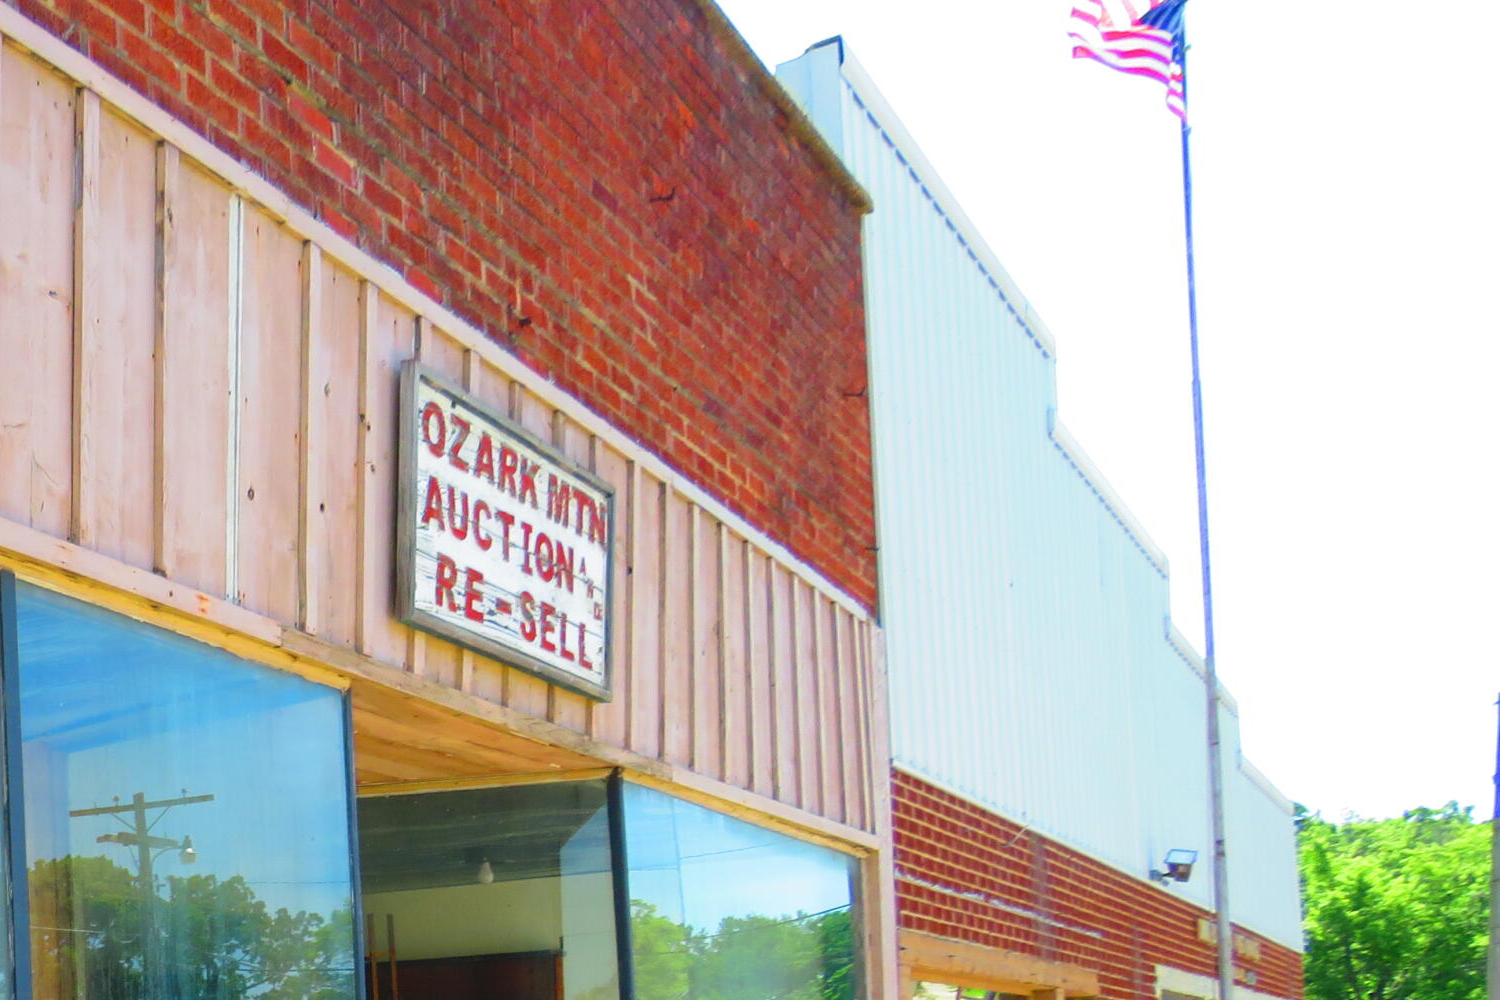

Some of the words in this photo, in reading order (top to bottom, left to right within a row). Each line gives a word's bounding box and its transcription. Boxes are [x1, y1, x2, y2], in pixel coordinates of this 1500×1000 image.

[421, 475, 574, 594] AUCTION
[422, 401, 541, 508] OZARK
[546, 474, 607, 549] MTN
[435, 552, 593, 671] RE-SELL
